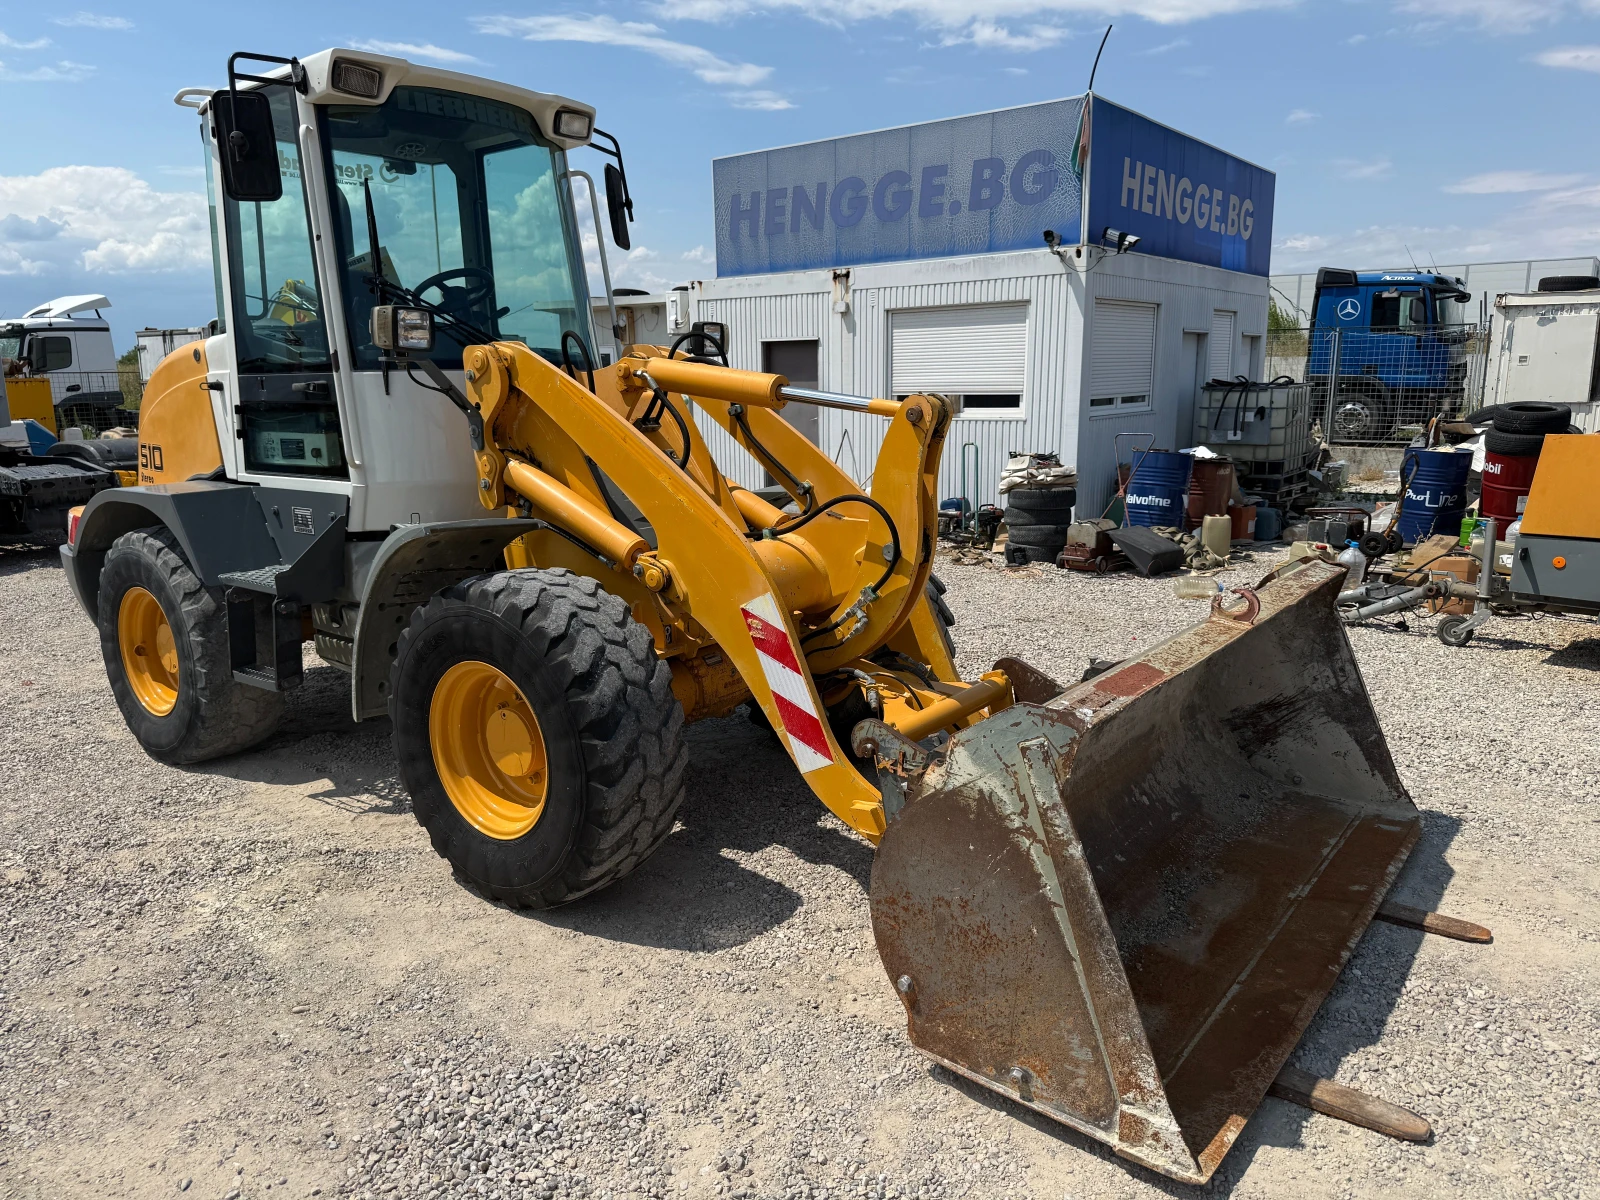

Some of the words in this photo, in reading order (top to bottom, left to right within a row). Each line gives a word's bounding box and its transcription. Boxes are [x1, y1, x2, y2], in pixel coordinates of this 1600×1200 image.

[730, 150, 1059, 240] HENGGE.BG
[1121, 156, 1254, 240] HENGGE.BG
[141, 444, 163, 470] 510
[1483, 461, 1501, 475] obil
[1126, 494, 1171, 507] Valvoline
